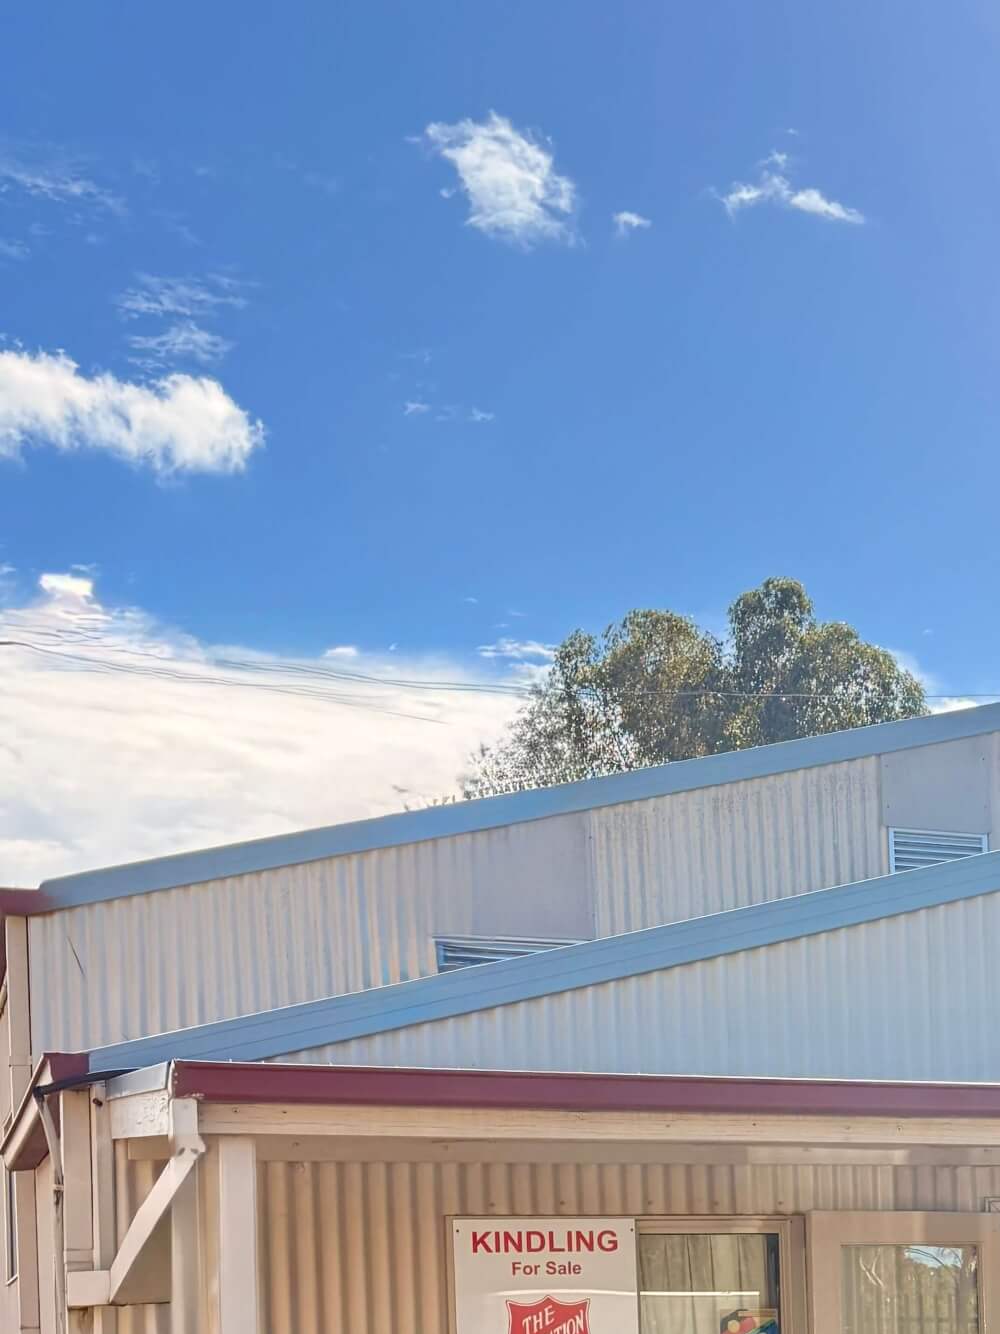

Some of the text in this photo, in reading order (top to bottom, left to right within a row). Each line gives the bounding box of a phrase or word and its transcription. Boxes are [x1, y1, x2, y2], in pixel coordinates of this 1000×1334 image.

[471, 1230, 619, 1254] KINDLING
[511, 1261, 582, 1276] For Sale
